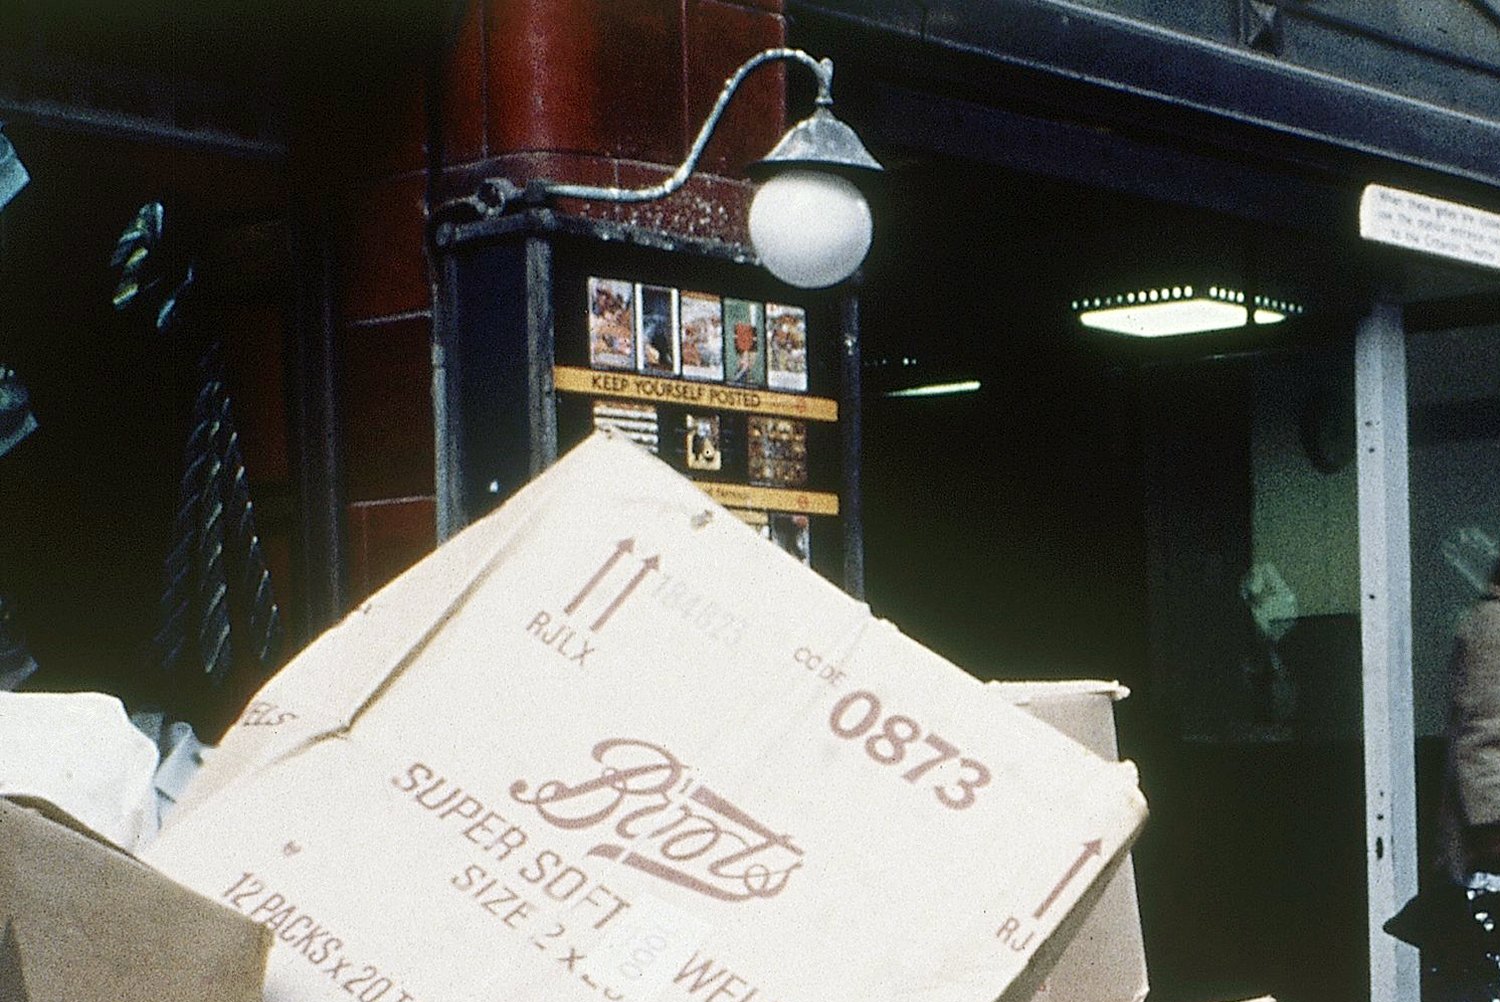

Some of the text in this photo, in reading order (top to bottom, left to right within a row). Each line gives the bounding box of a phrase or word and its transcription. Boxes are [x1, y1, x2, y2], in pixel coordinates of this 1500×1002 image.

[591, 375, 761, 408] KEEP YOURSELF POSTED
[525, 610, 597, 667] RJLX
[829, 690, 992, 811] 0873
[392, 762, 527, 862] SUPER
[518, 849, 631, 930] SOFT
[509, 738, 804, 903] Boots
[222, 871, 262, 907] 12
[250, 891, 343, 965] PACKS
[322, 954, 354, 980] x
[450, 863, 536, 929] SIZE
